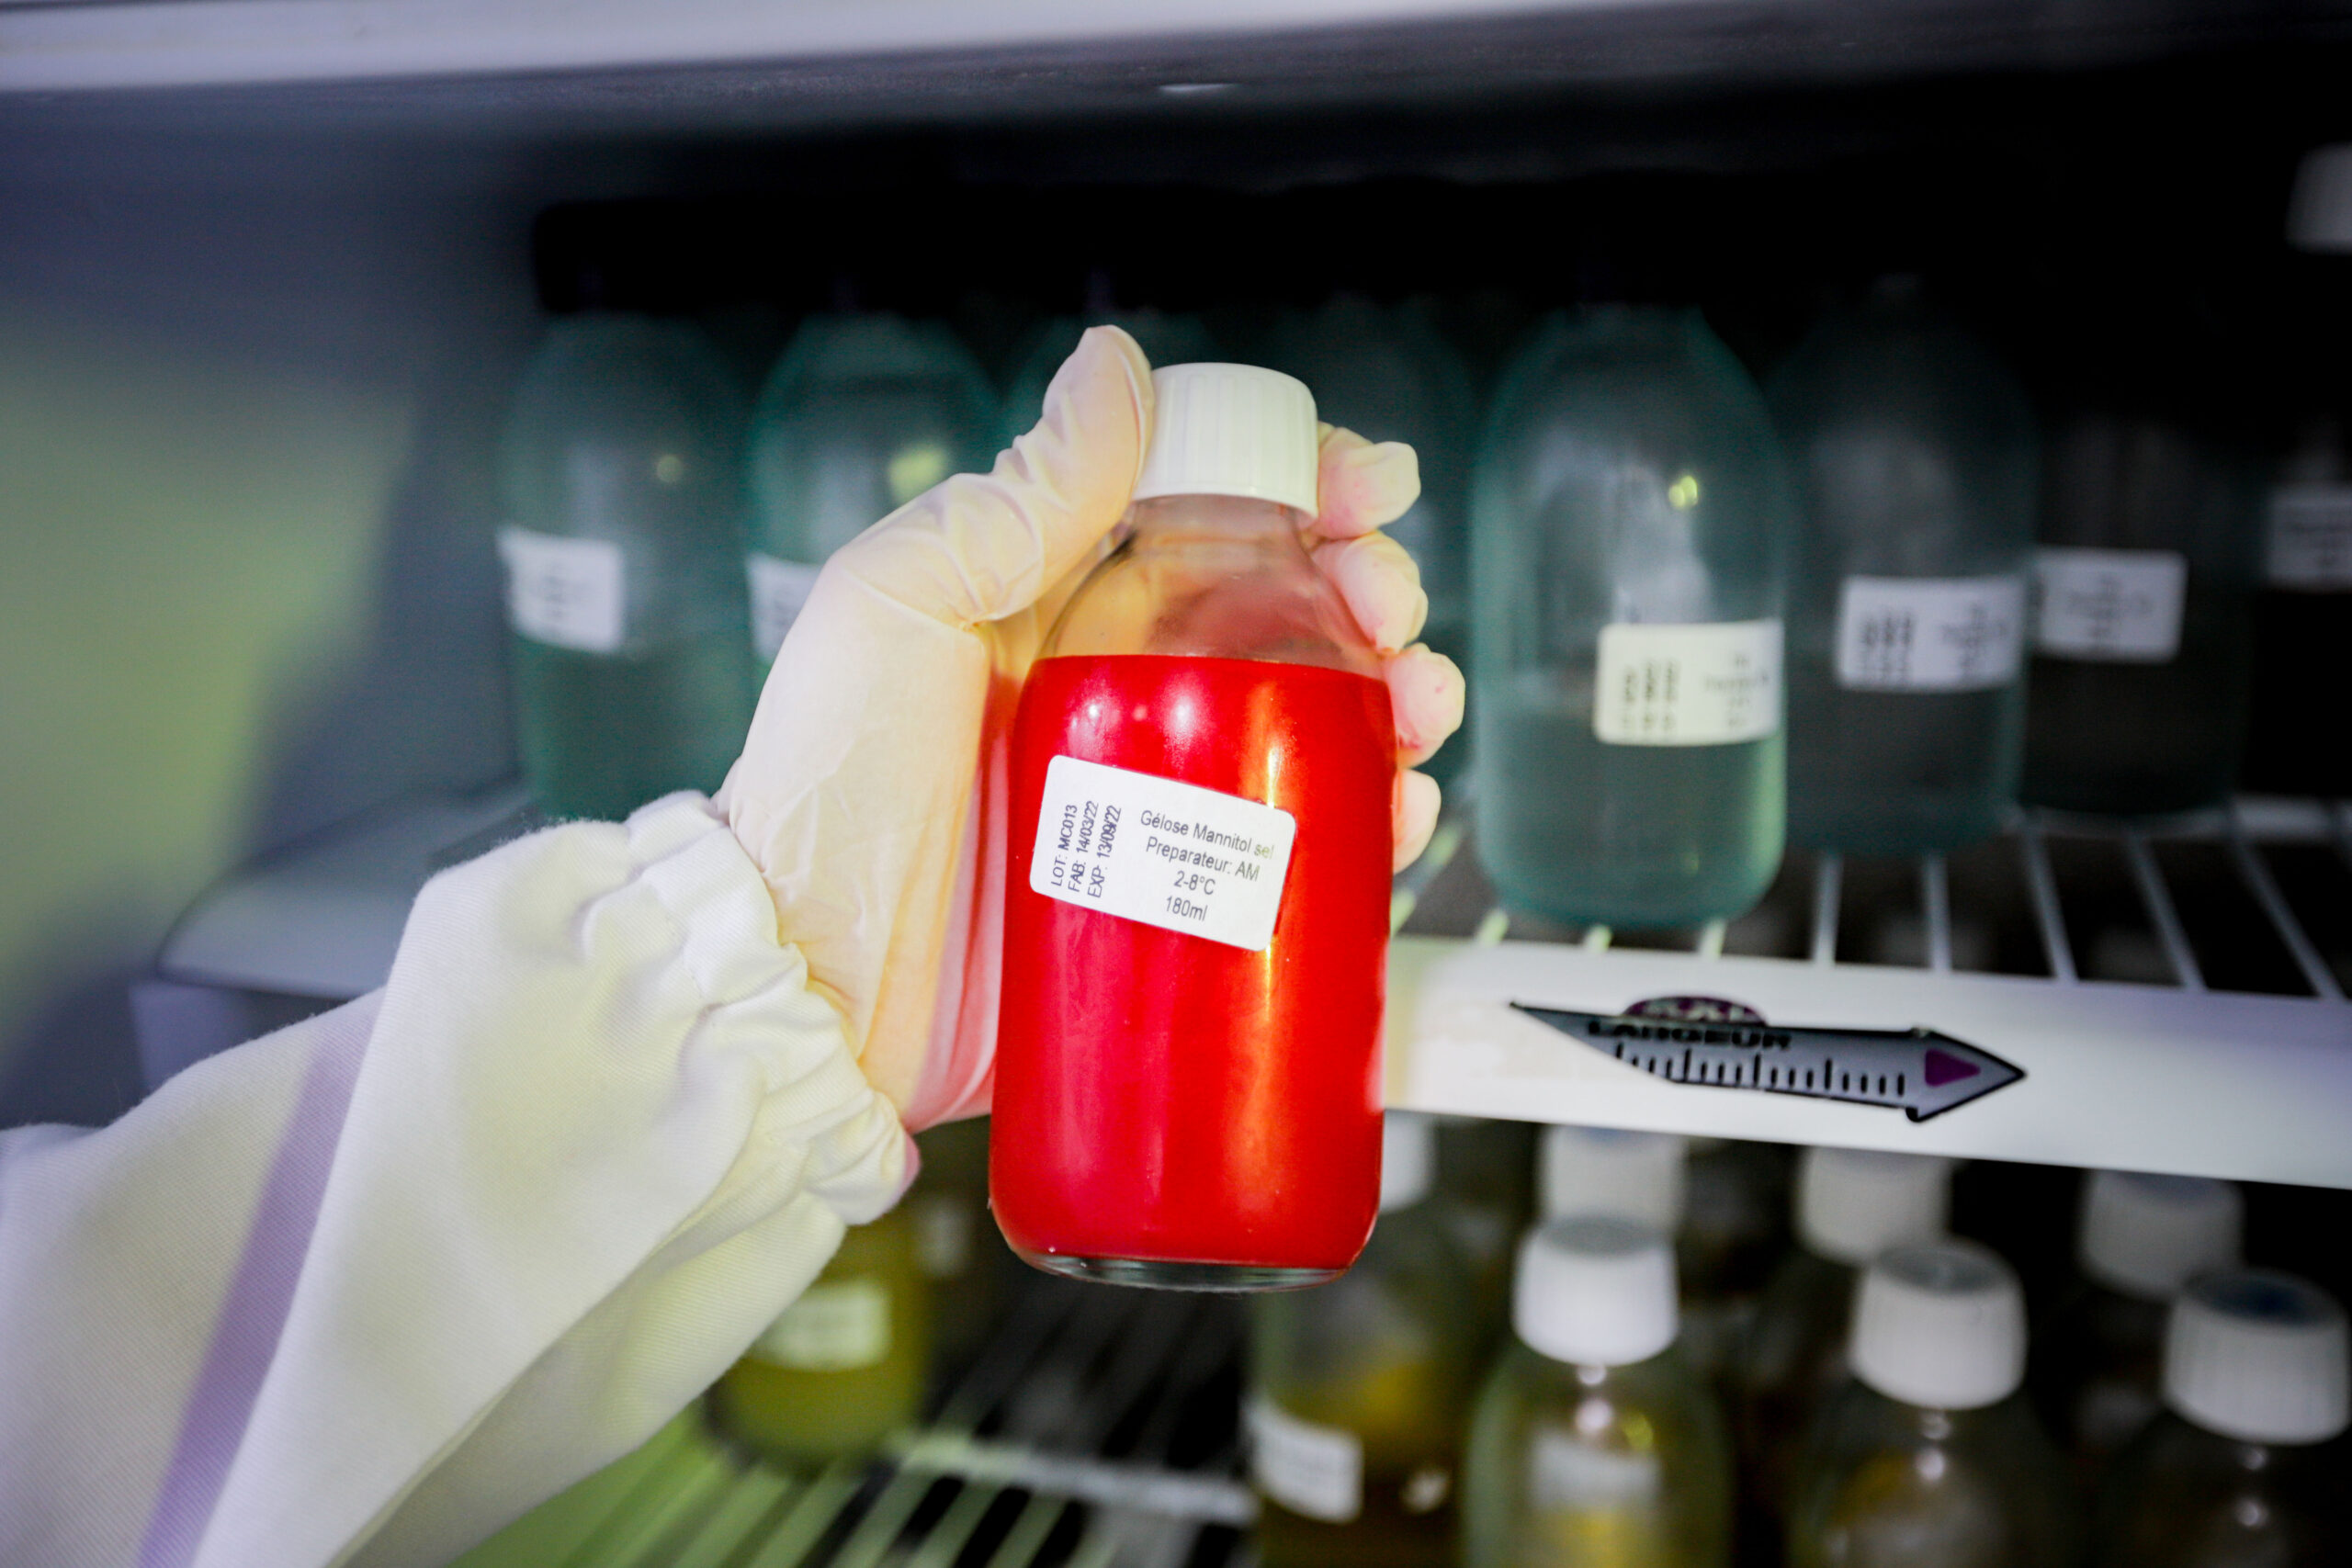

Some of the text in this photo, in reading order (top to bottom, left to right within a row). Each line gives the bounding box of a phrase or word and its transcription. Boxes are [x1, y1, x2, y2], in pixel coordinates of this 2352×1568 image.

[1050, 804, 1078, 886] LOT: MC013
[1068, 800, 1099, 893] FAB: 14/03/22
[1096, 805, 1121, 858] 13/09/22
[1140, 809, 1275, 860] Gélose Mannitol sel
[1146, 836, 1261, 882] Preparateur: AM
[1173, 870, 1216, 896] 2-8°C
[1166, 896, 1208, 921] 180ml
